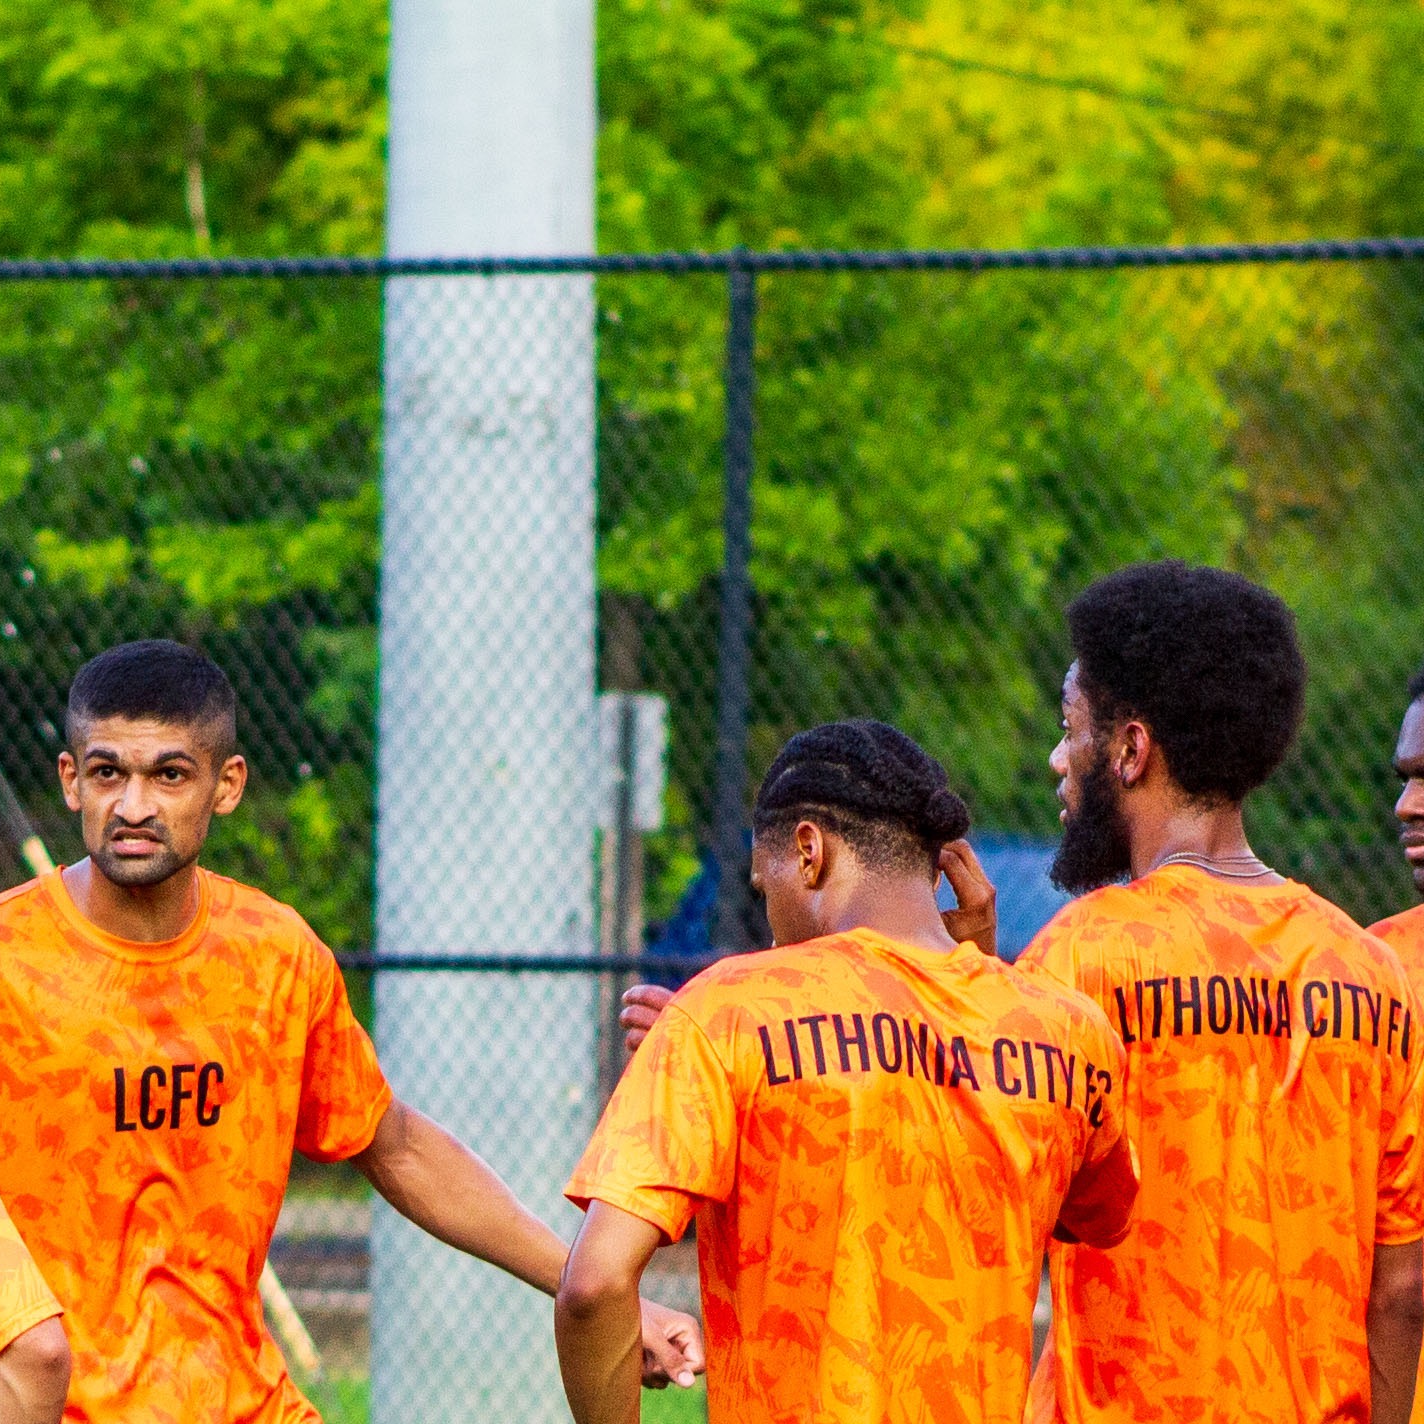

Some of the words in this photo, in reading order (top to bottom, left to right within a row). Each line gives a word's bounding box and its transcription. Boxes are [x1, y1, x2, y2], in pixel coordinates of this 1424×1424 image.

[1114, 974, 1292, 1044] LITHONIA
[1301, 979, 1382, 1047] CITY
[113, 1061, 225, 1132] LCFC
[757, 1012, 981, 1092] LITHONIA
[992, 1037, 1076, 1110] CITY
